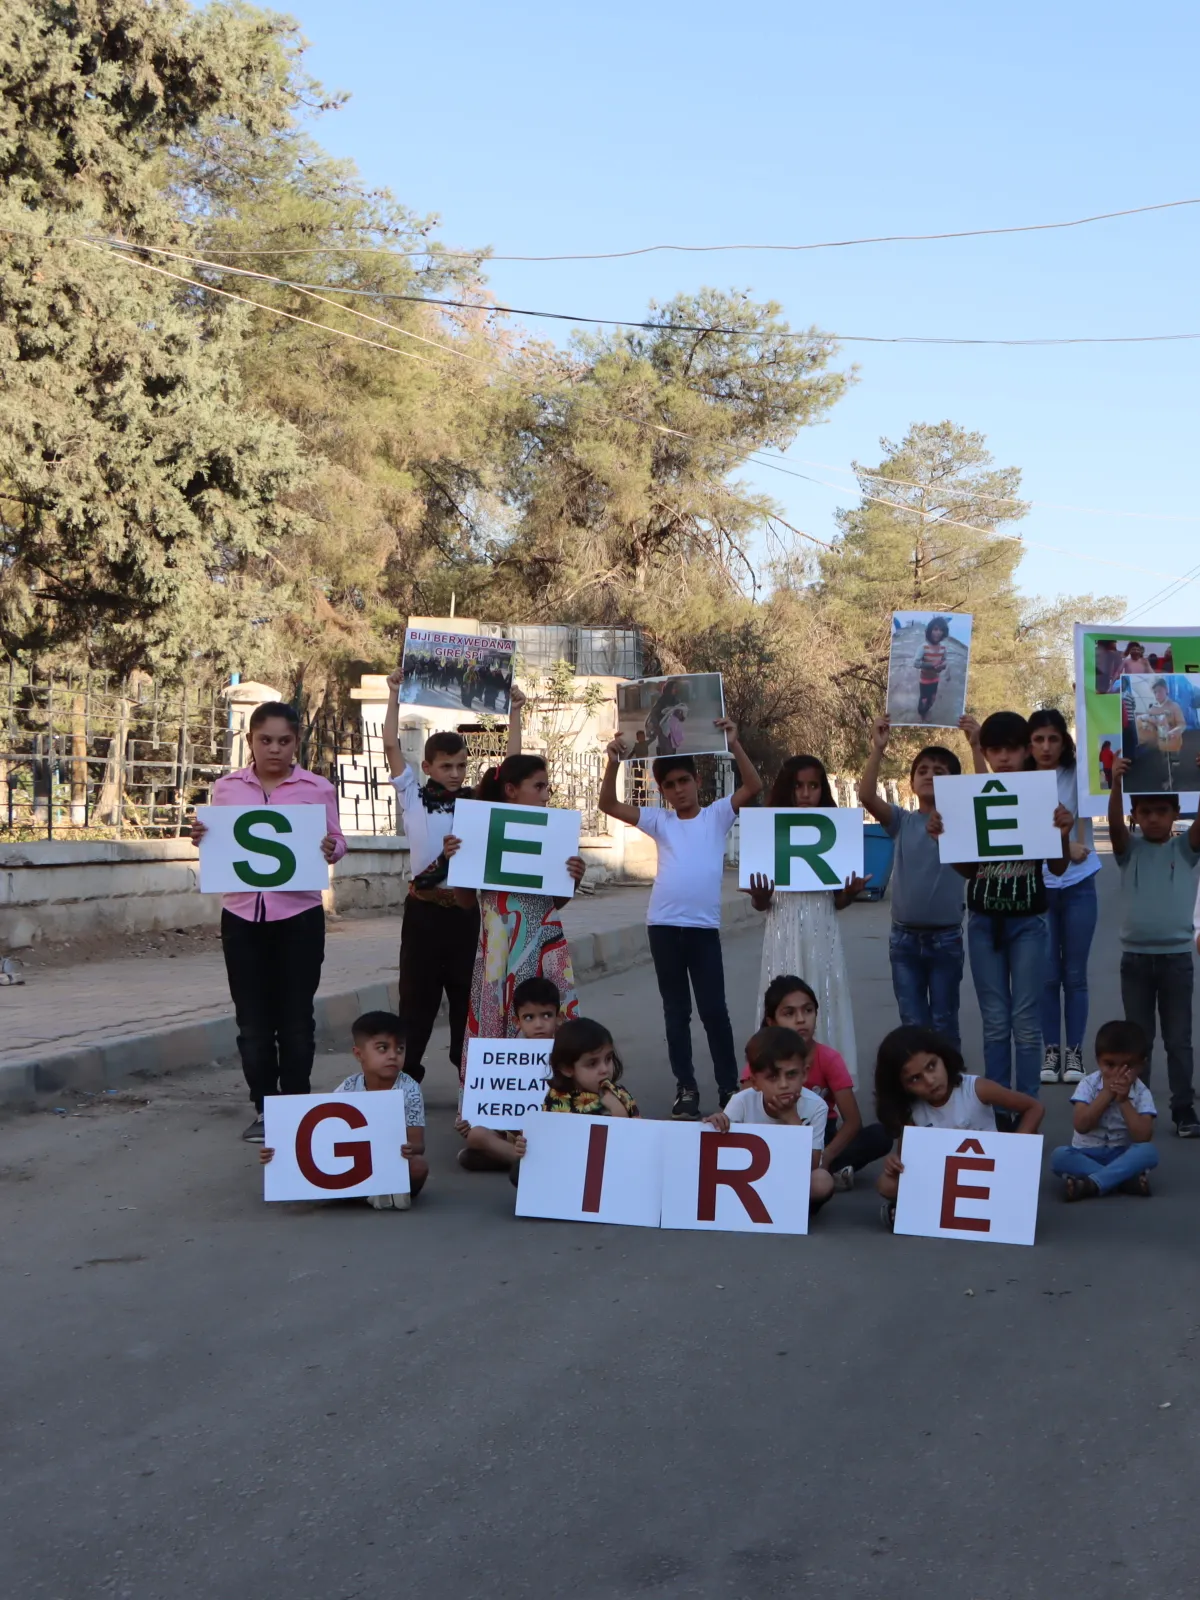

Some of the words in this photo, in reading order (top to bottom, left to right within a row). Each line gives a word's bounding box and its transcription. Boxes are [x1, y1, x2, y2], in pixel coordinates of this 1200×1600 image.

[433, 634, 512, 650] BERXWEDANA
[232, 810, 297, 887] S
[484, 808, 549, 889] E
[774, 813, 842, 886] R
[972, 780, 1023, 857] Ê
[470, 1077, 484, 1090] JI
[483, 1052, 551, 1066] DERBIK
[295, 1102, 373, 1190] G
[582, 1123, 608, 1213] I
[697, 1131, 773, 1224] R
[940, 1138, 995, 1232] Ê
